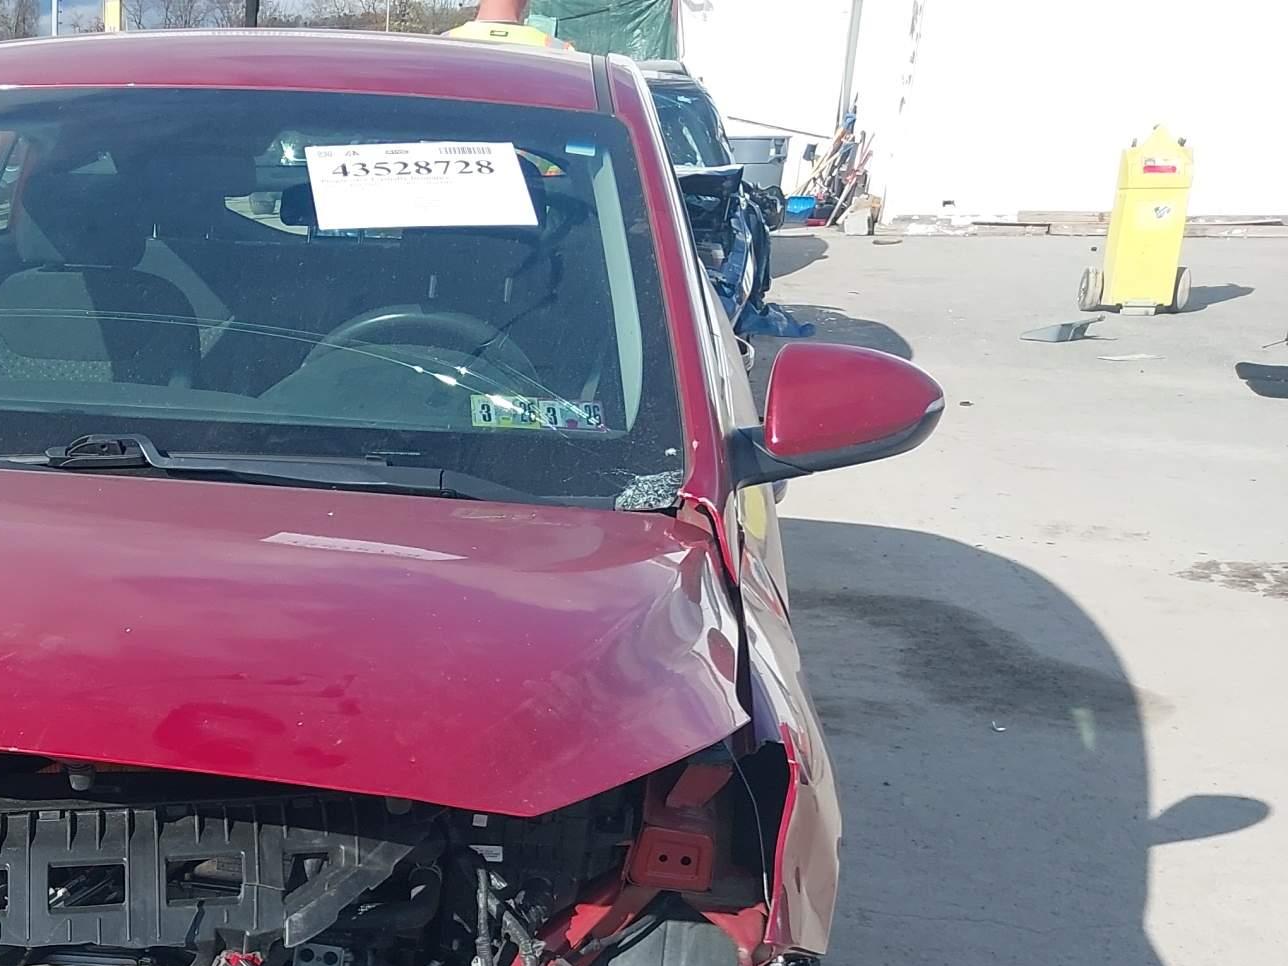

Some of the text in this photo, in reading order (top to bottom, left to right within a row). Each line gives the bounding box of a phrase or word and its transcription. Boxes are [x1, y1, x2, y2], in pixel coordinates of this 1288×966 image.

[332, 159, 495, 177] 43528728
[480, 403, 492, 423] 3
[546, 404, 602, 426] 3 26
